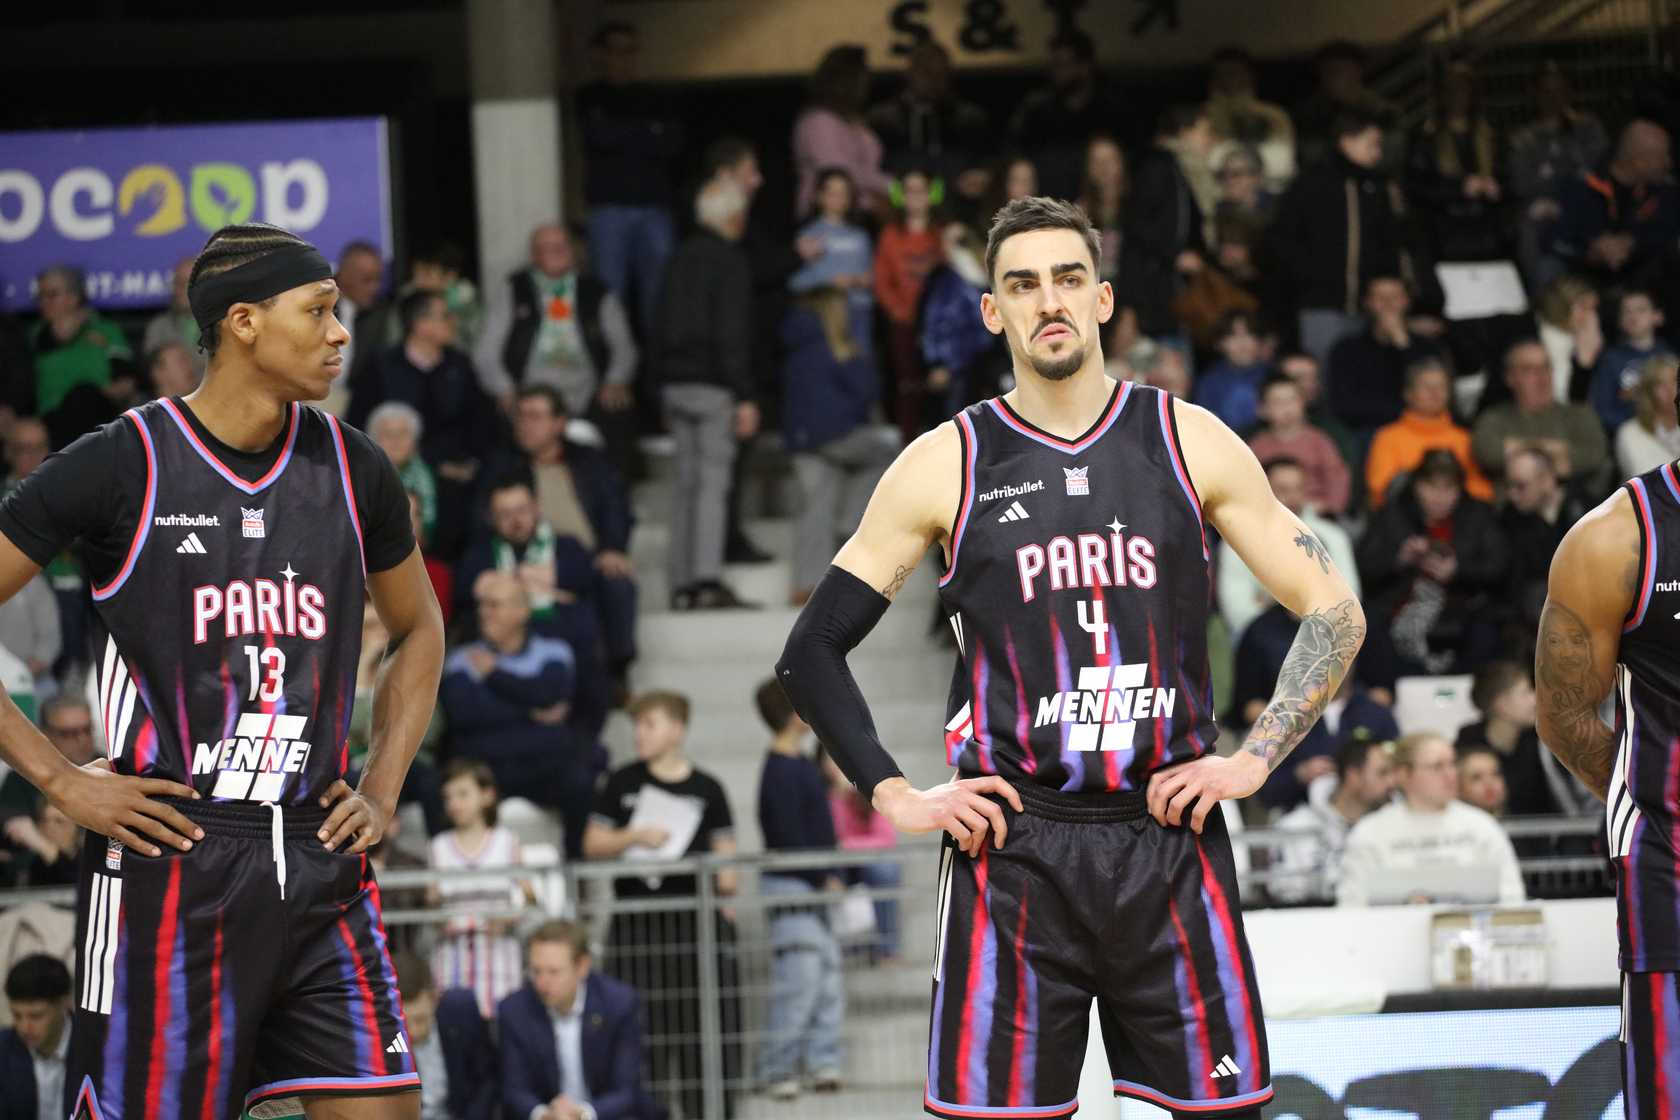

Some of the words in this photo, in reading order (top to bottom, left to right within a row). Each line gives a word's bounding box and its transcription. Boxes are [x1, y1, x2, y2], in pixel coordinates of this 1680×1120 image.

[243, 528, 263, 537] ELITE
[1016, 532, 1157, 603] PARIS
[193, 577, 326, 644] PARIS
[1076, 600, 1109, 655] 4
[244, 645, 286, 702] 13
[1034, 687, 1176, 728] MENNEN
